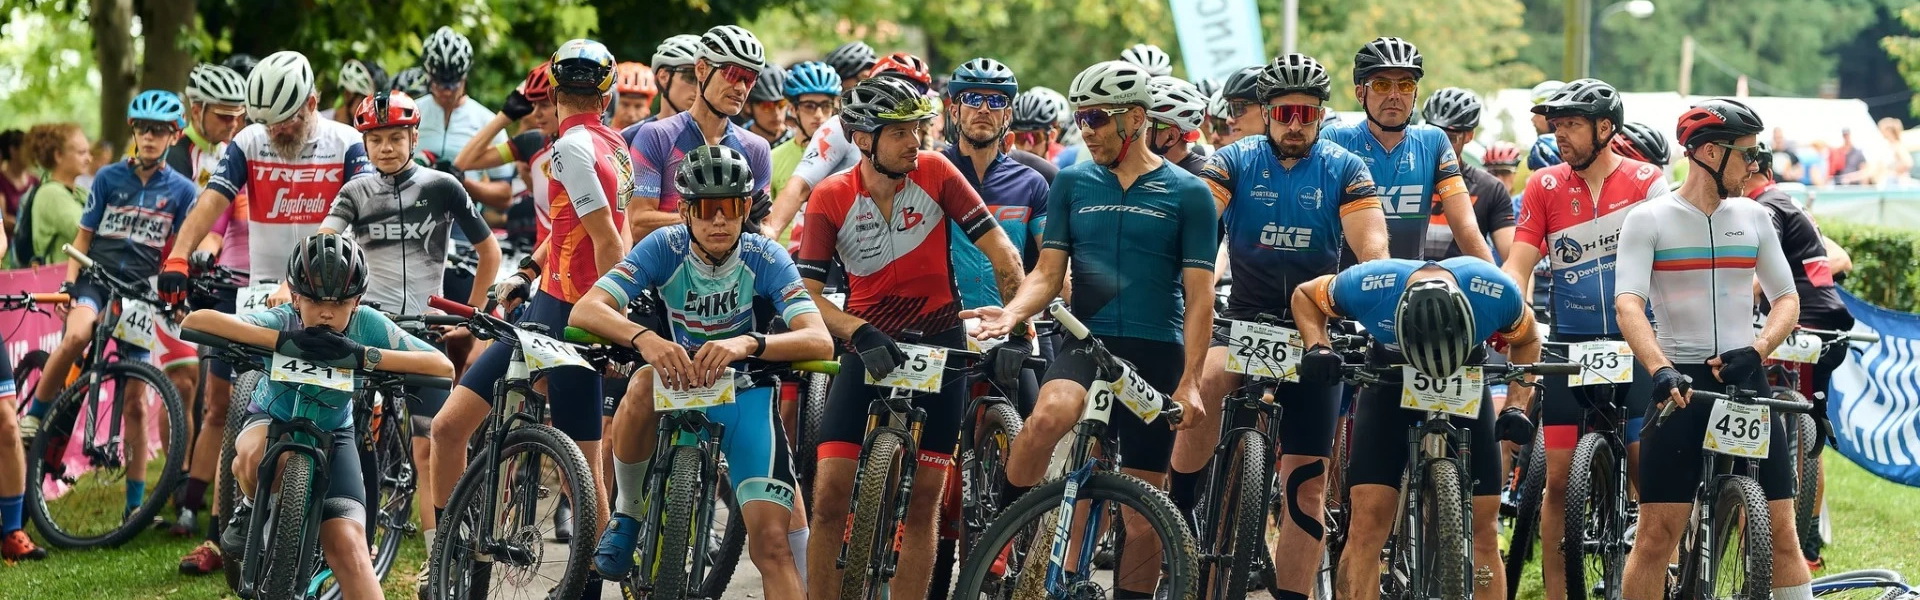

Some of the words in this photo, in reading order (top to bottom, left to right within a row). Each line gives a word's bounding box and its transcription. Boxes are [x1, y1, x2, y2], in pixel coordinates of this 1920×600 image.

[253, 165, 343, 182] TREK
[266, 188, 326, 218] Segafredo
[1078, 204, 1167, 219] corratec
[1236, 335, 1288, 362] 256
[282, 360, 333, 379] 421
[1579, 352, 1619, 371] 453
[1413, 372, 1462, 397] 501
[1715, 414, 1761, 441] 436
